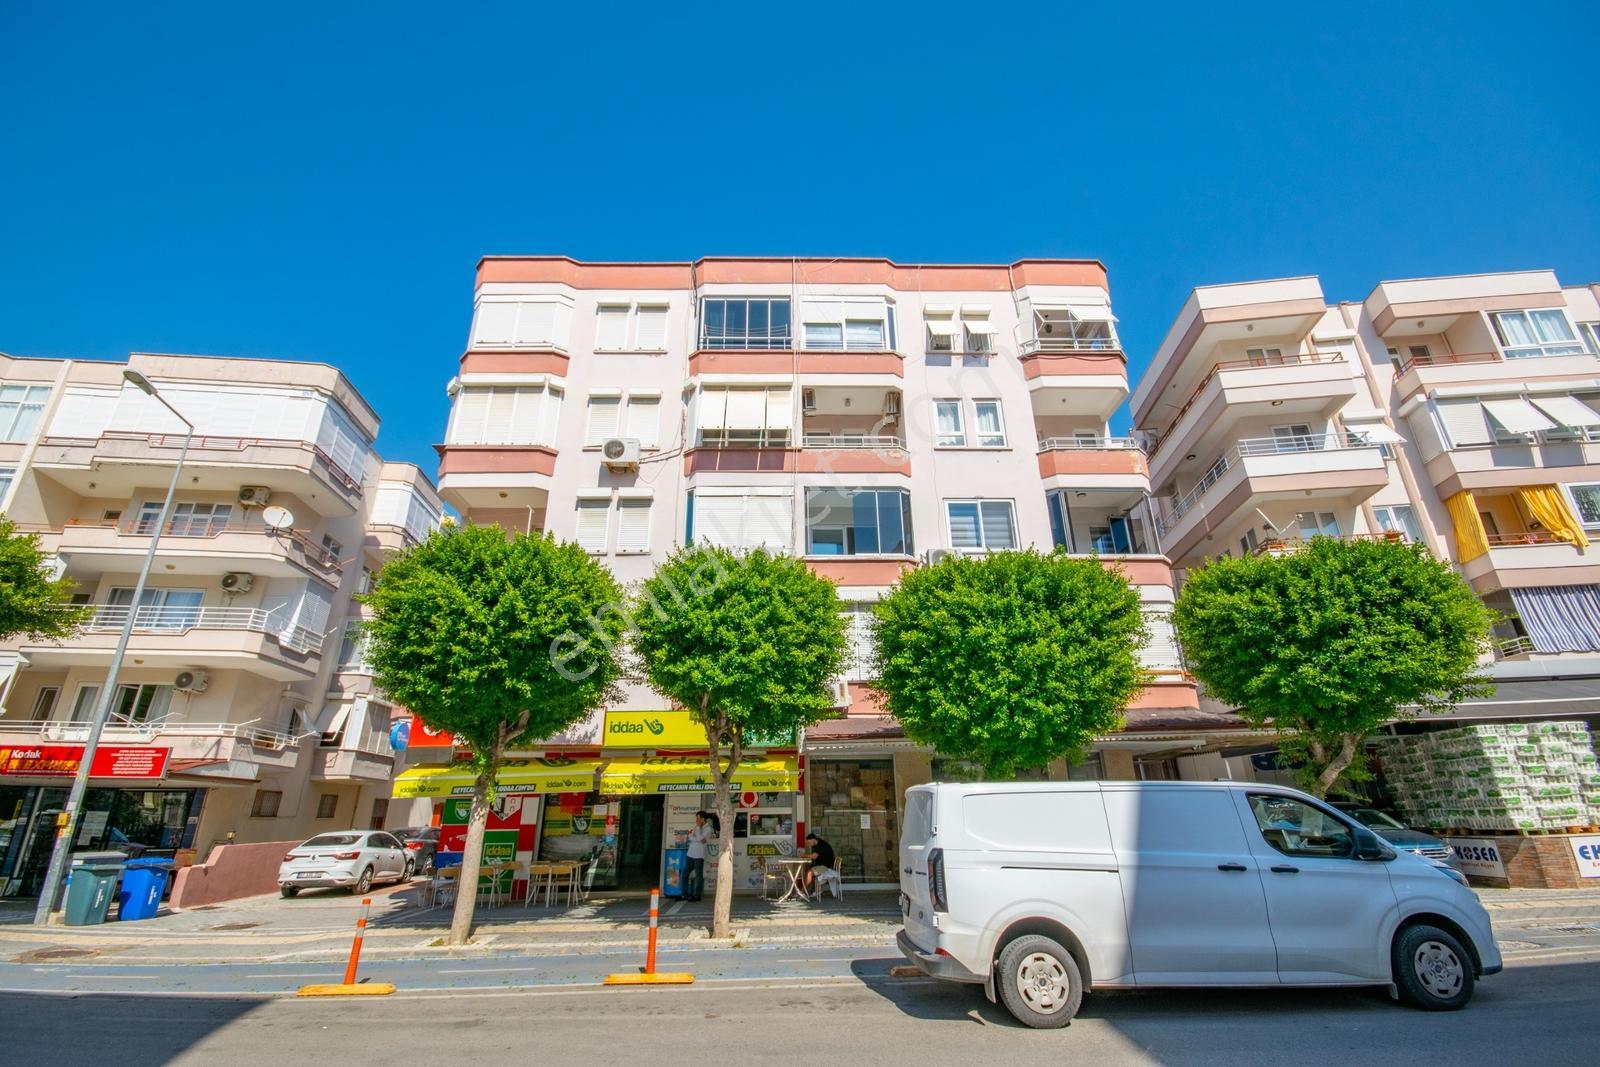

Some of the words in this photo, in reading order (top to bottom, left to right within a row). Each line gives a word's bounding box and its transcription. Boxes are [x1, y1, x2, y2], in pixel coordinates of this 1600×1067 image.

[609, 721, 644, 733] iddaa
[11, 749, 41, 759] Kodak
[1454, 846, 1498, 862] KOSER
